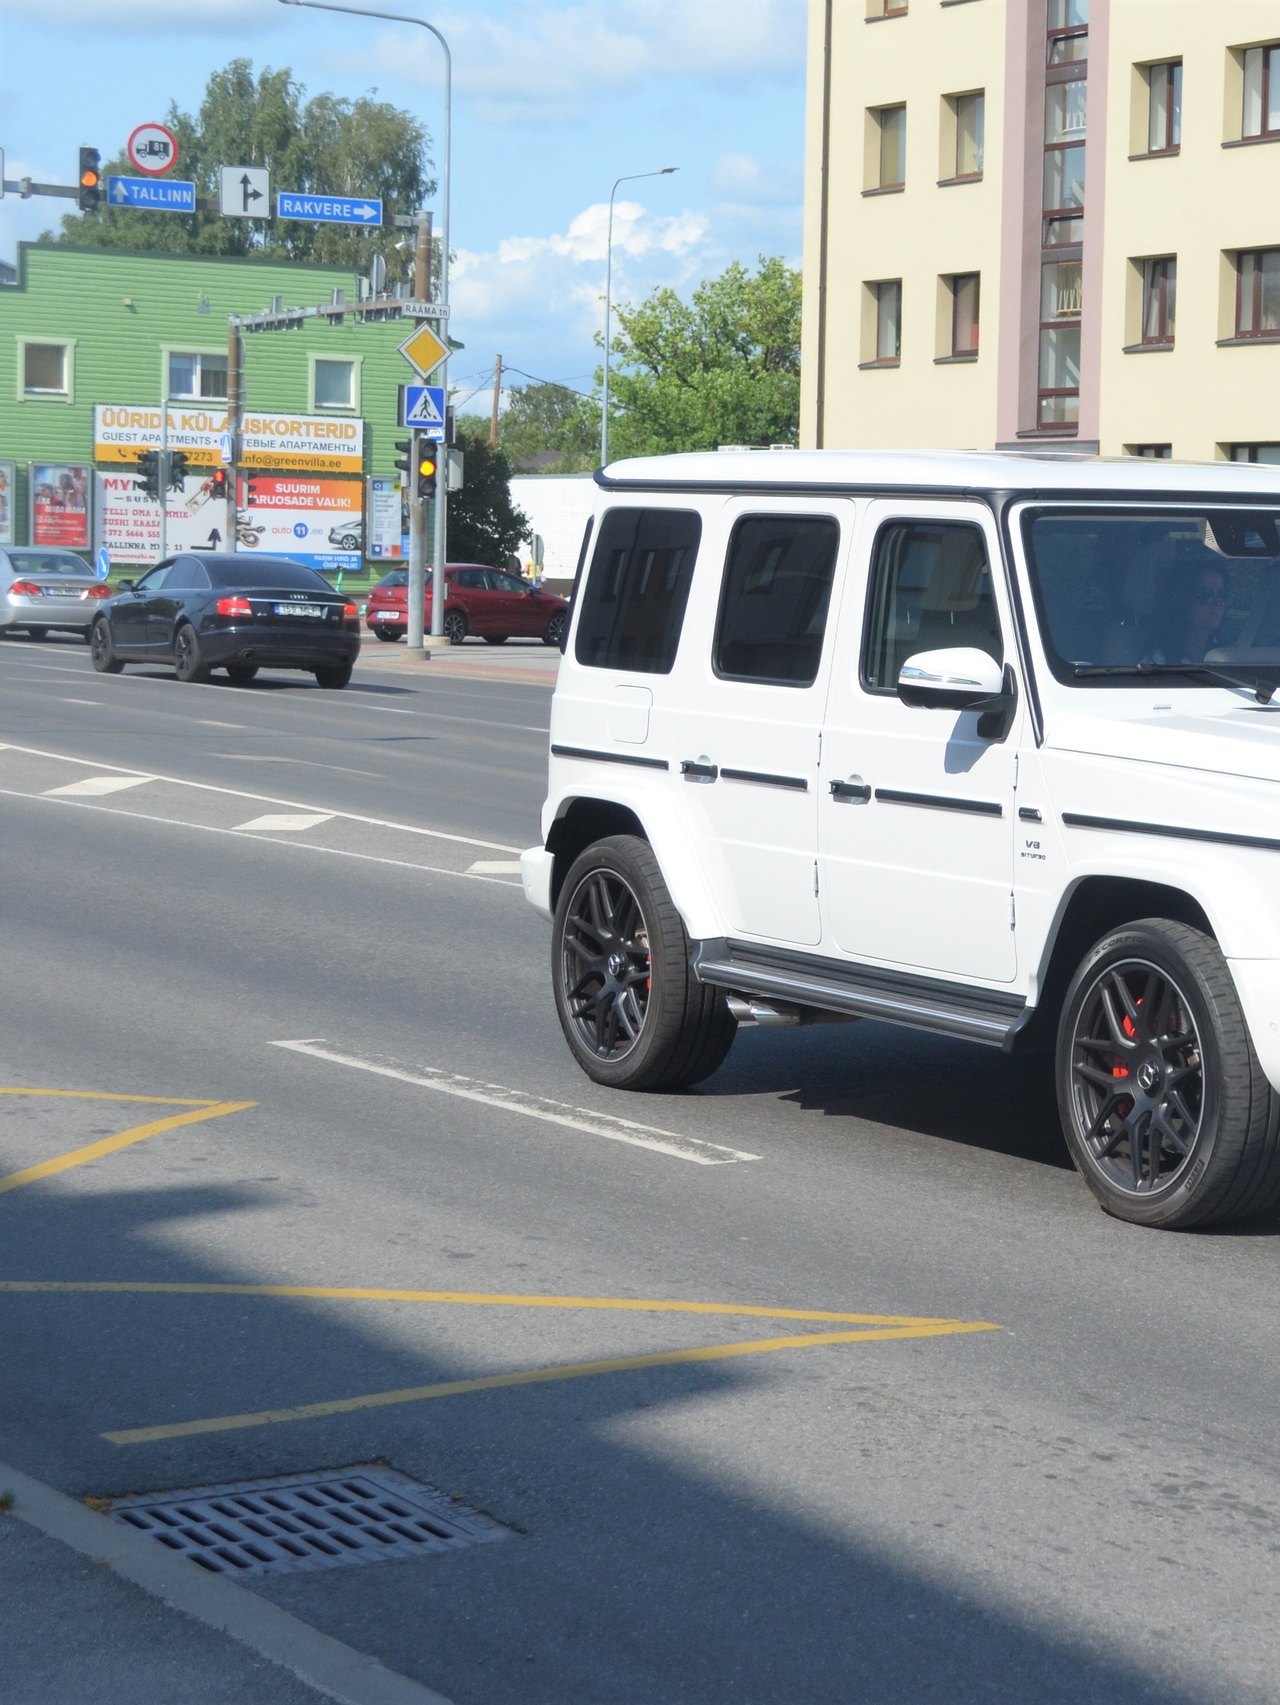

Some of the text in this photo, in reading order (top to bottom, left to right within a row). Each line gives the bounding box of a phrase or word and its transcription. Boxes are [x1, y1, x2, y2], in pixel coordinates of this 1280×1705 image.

[153, 142, 164, 151] 8t
[131, 186, 192, 204] TALLINN
[284, 199, 351, 217] RAKVERE
[405, 304, 448, 316] RAAMA tn
[102, 407, 176, 430] ÜÜRIDA
[102, 432, 138, 442] GUEST
[280, 441, 357, 453] АПАРТАМЕНТЫ
[244, 454, 341, 468] nfo@greenvilla.ee
[275, 483, 320, 494] SUURIM
[316, 497, 351, 507] VALIK!
[103, 508, 192, 518] TELLI OMA LMMIK-
[103, 518, 129, 526] SUSHI
[272, 526, 292, 534] auto
[295, 527, 306, 535] 11
[102, 541, 147, 550] TALLINNA
[1025, 840, 1041, 849] V8
